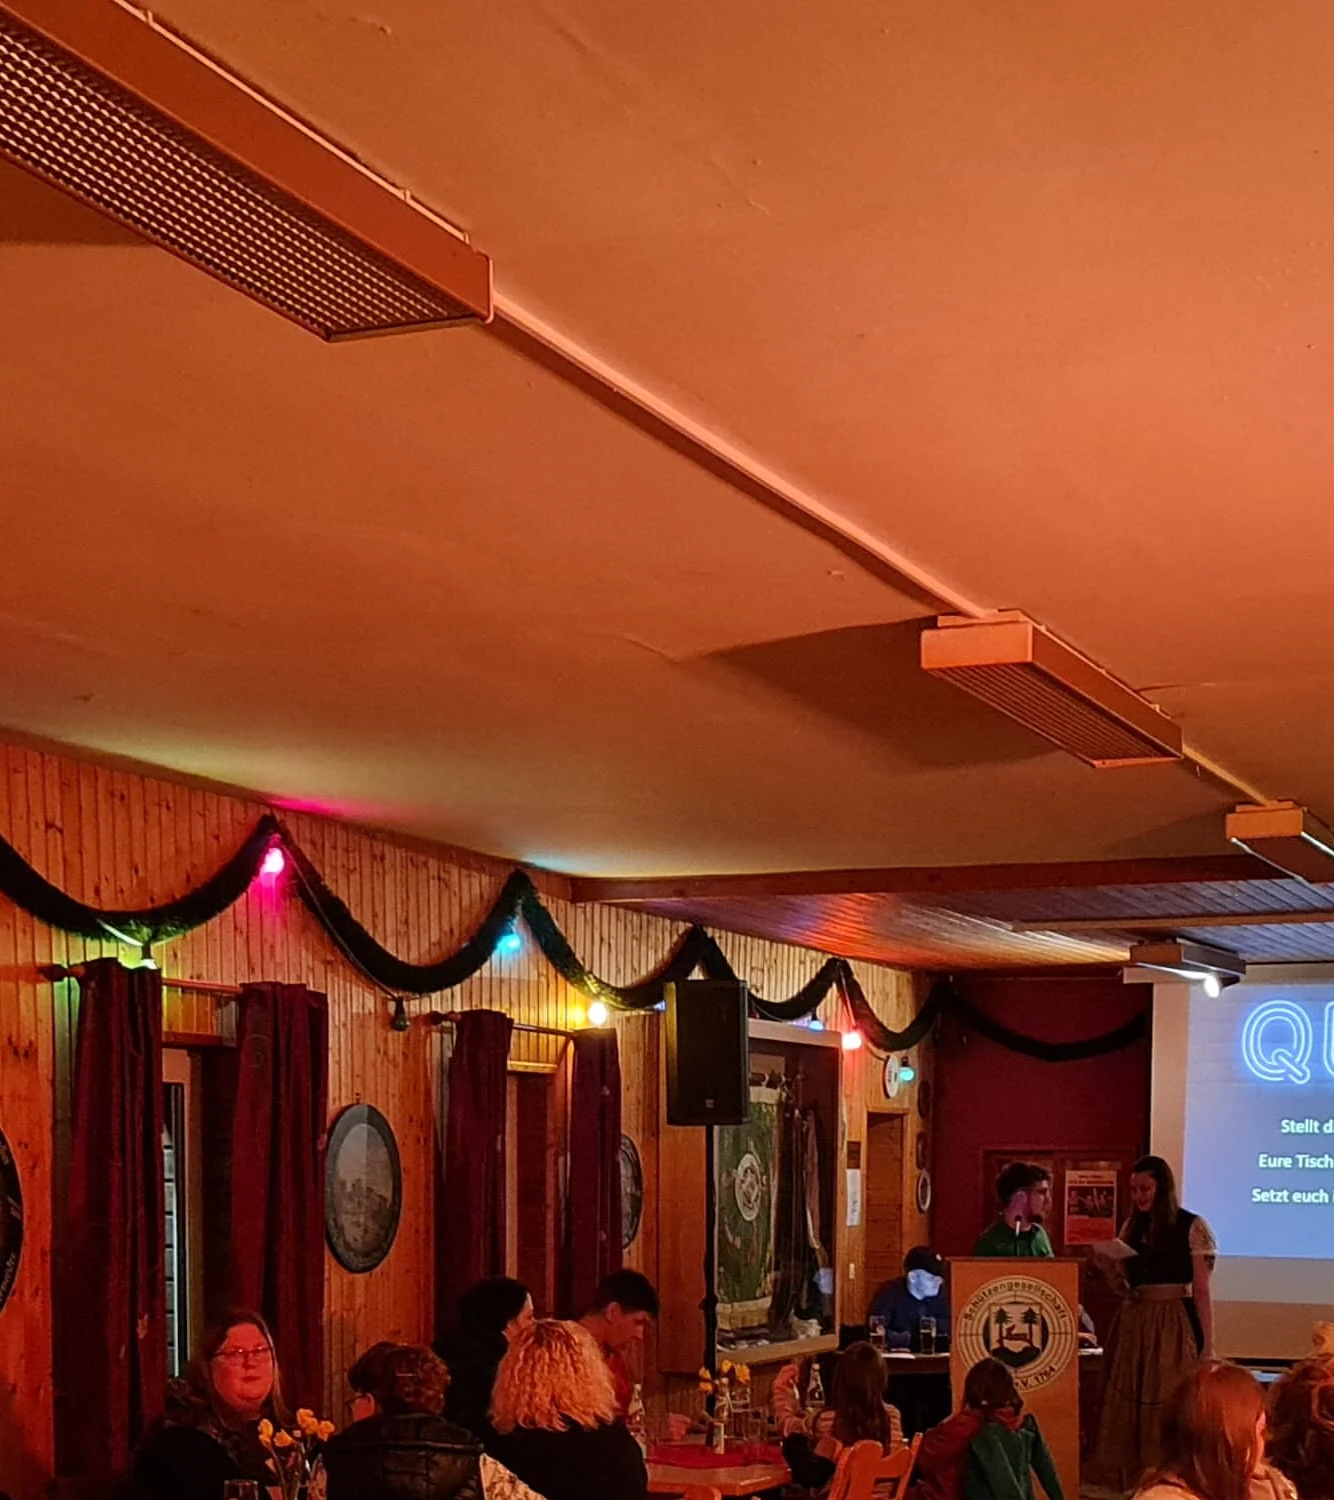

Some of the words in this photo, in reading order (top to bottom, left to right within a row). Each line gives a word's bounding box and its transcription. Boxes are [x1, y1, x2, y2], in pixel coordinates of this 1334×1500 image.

[1280, 1118, 1320, 1134] Stellt
[1258, 1153, 1293, 1168] Eure
[1251, 1188, 1290, 1203] Setzt
[1291, 1188, 1329, 1203] euch
[964, 1281, 1067, 1321] Schützengesellschaft
